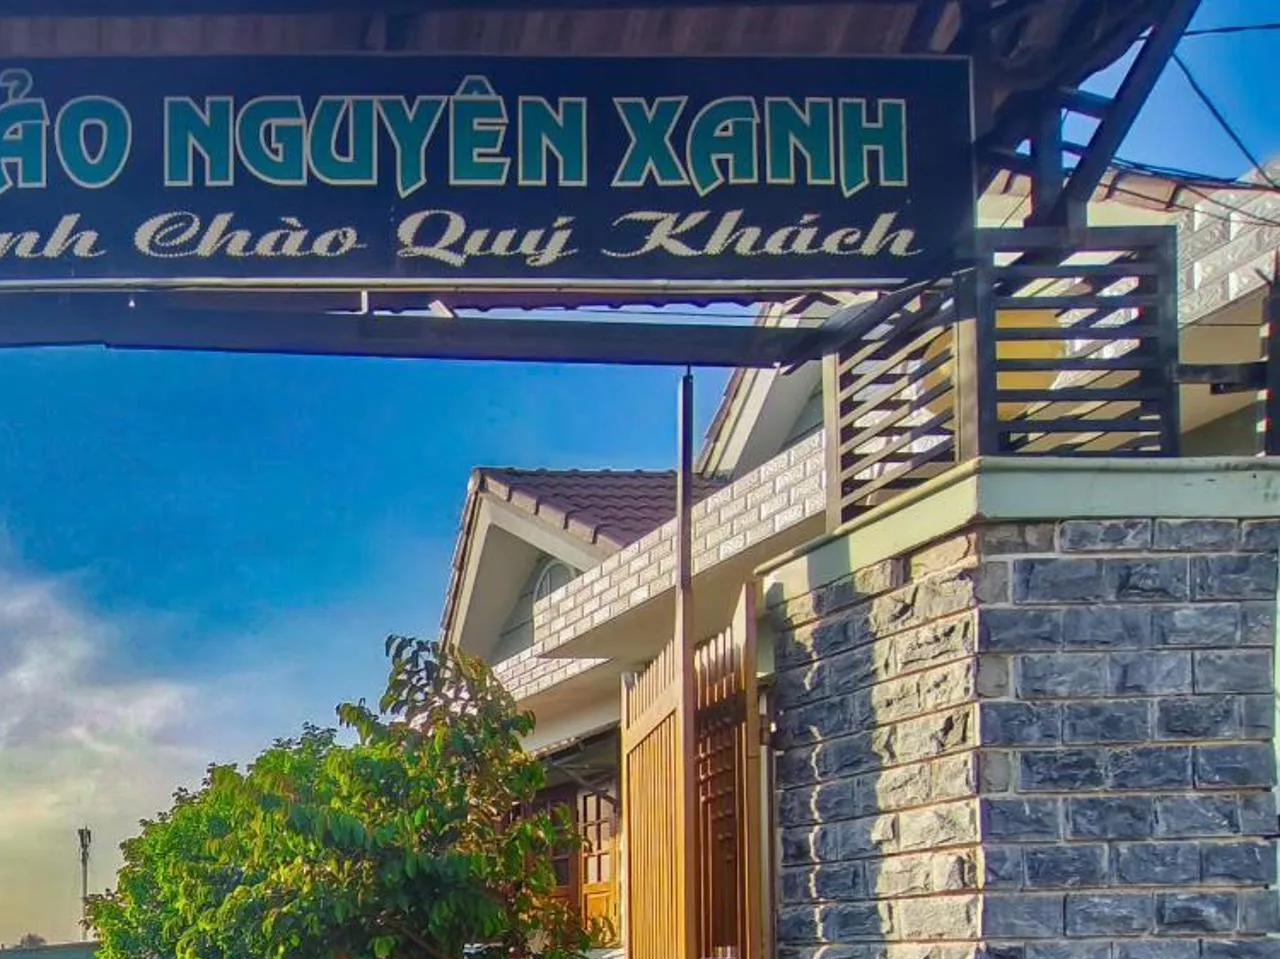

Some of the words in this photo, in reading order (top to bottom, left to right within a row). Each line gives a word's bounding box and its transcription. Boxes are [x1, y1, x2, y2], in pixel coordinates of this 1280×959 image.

[164, 75, 588, 199] NGUYÊN
[612, 96, 909, 198] XANH
[134, 211, 368, 258] Chào
[396, 209, 579, 268] Quý
[600, 209, 923, 257] Khách
